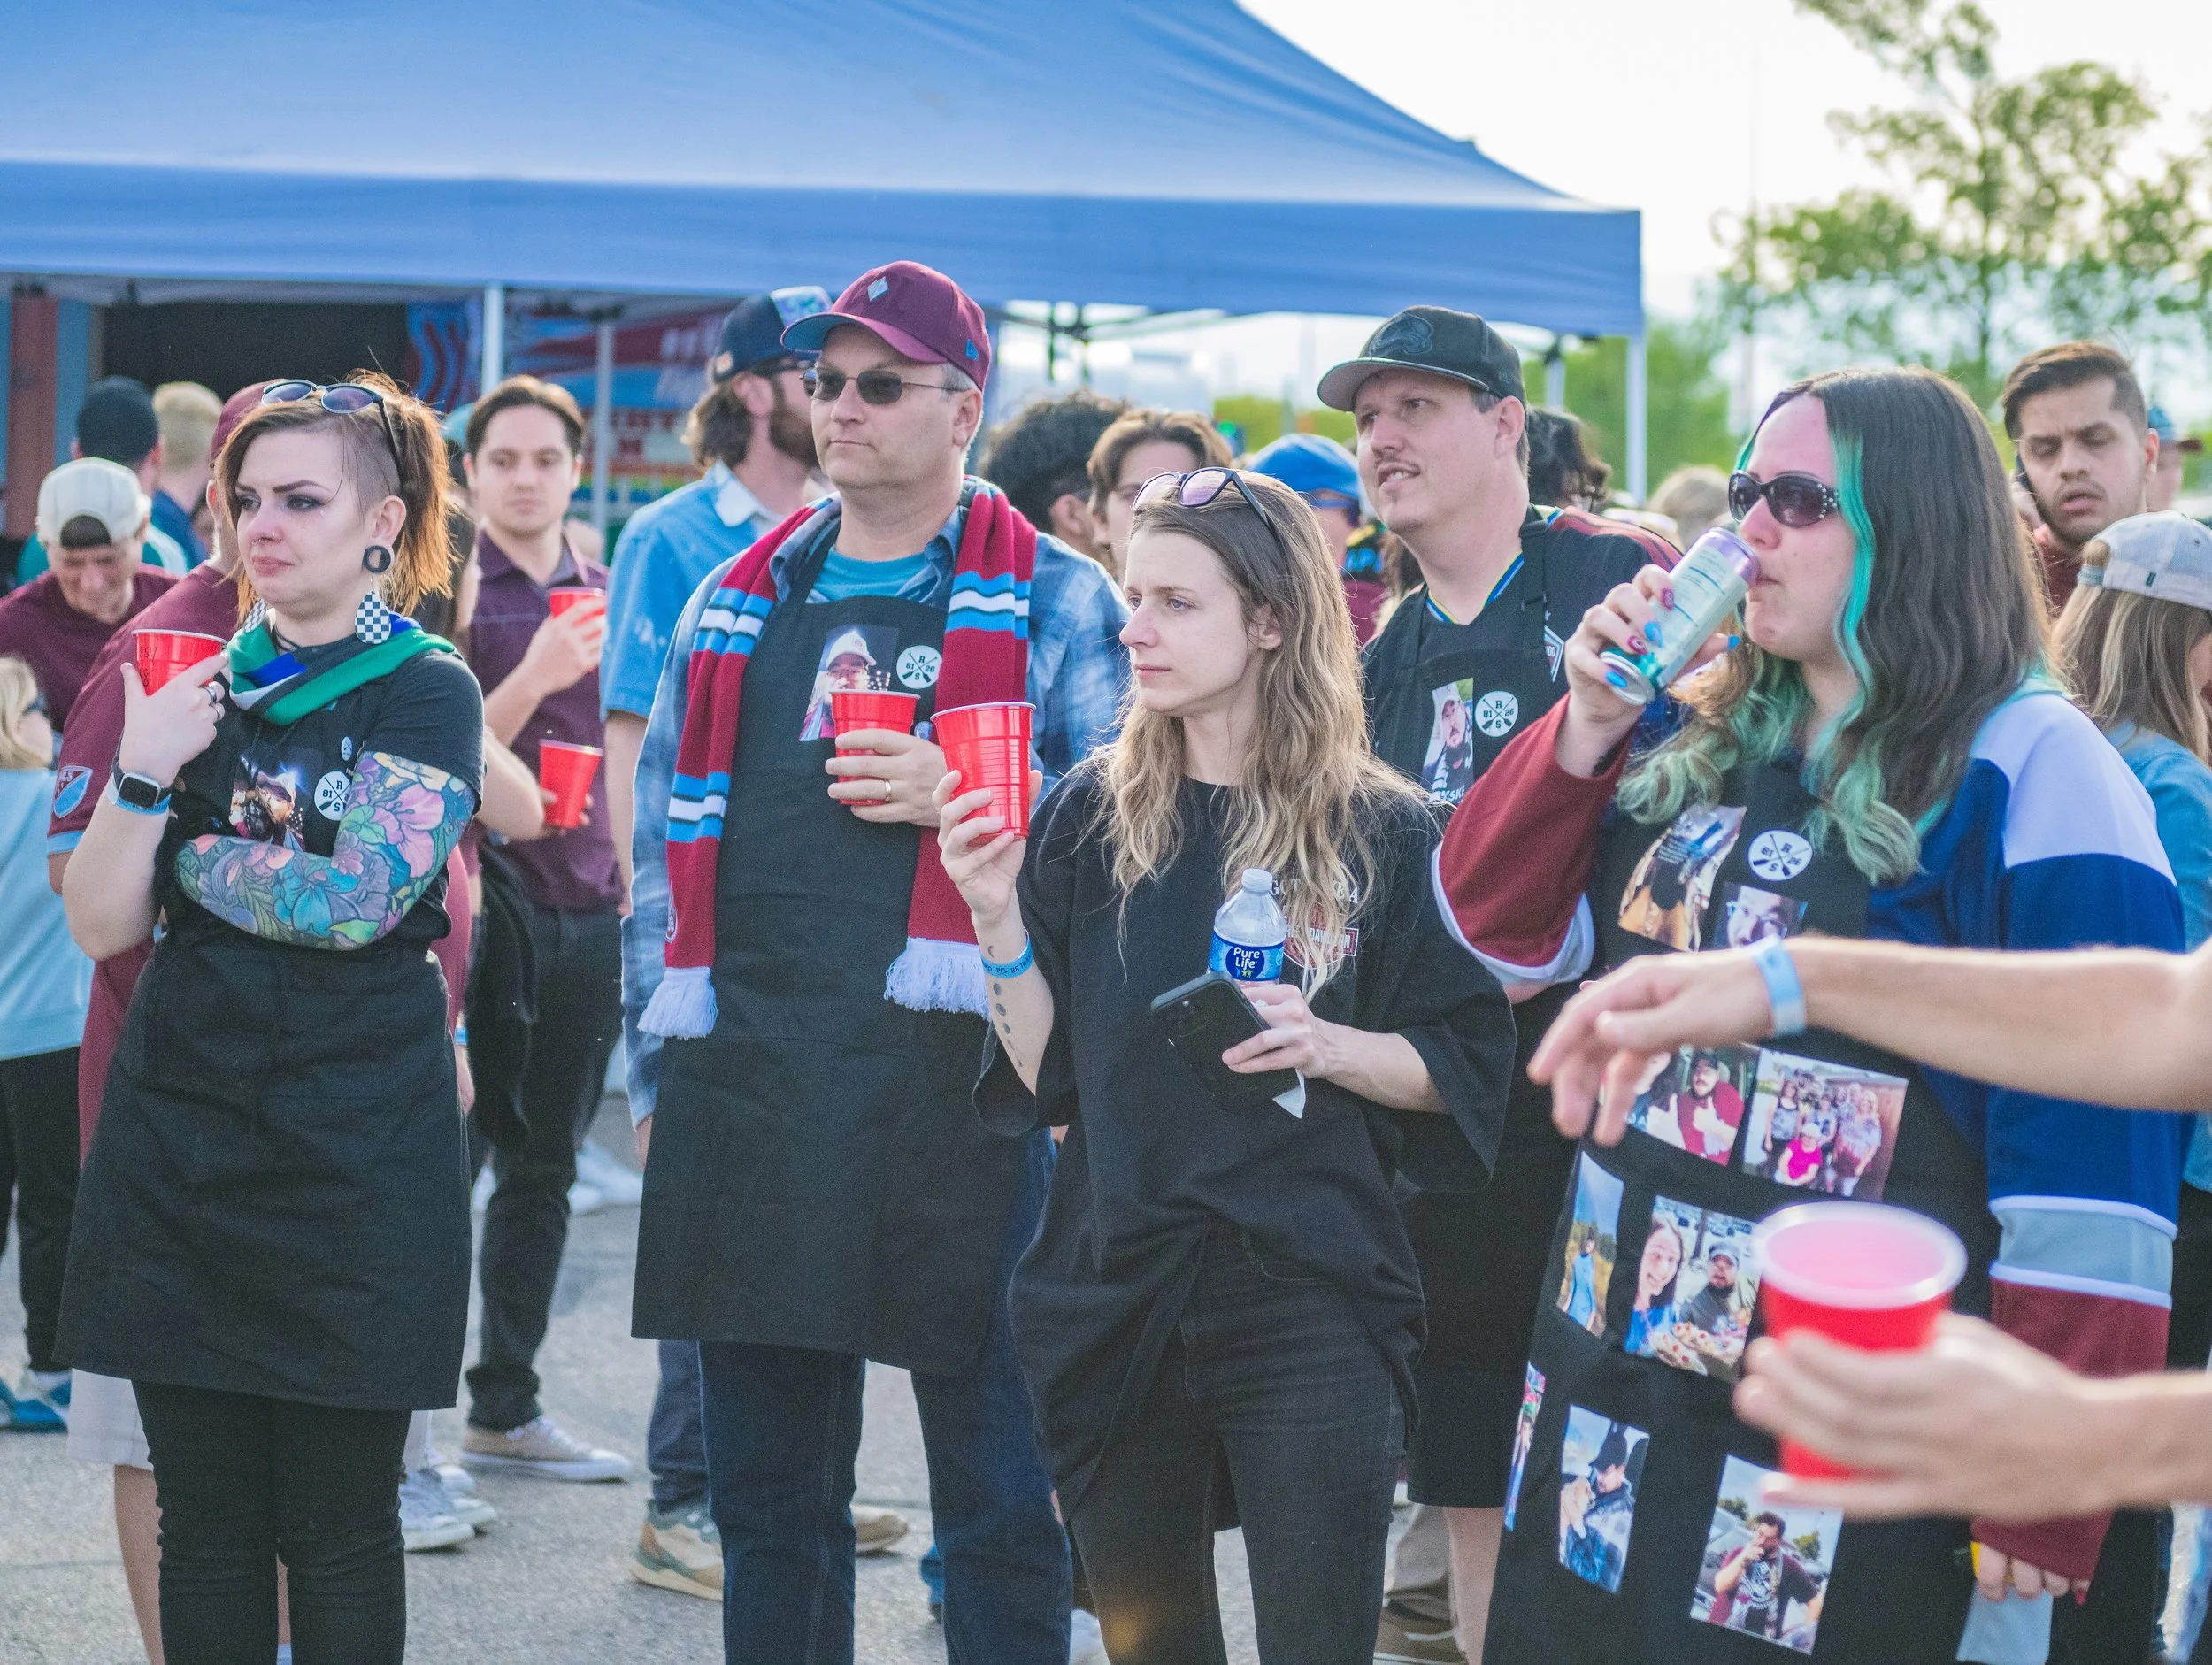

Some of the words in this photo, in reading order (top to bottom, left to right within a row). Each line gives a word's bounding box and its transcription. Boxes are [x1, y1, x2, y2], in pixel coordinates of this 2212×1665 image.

[1495, 700, 1502, 709] R
[1483, 710, 1493, 718] 81
[1504, 708, 1515, 717] 26
[1495, 719, 1502, 729] S
[336, 780, 343, 790] R
[322, 789, 333, 798] 81
[334, 802, 341, 812] S
[1781, 842, 1793, 854] R
[1769, 863, 1779, 872] S
[1233, 947, 1261, 959] Pure
[1235, 956, 1256, 971] Life
